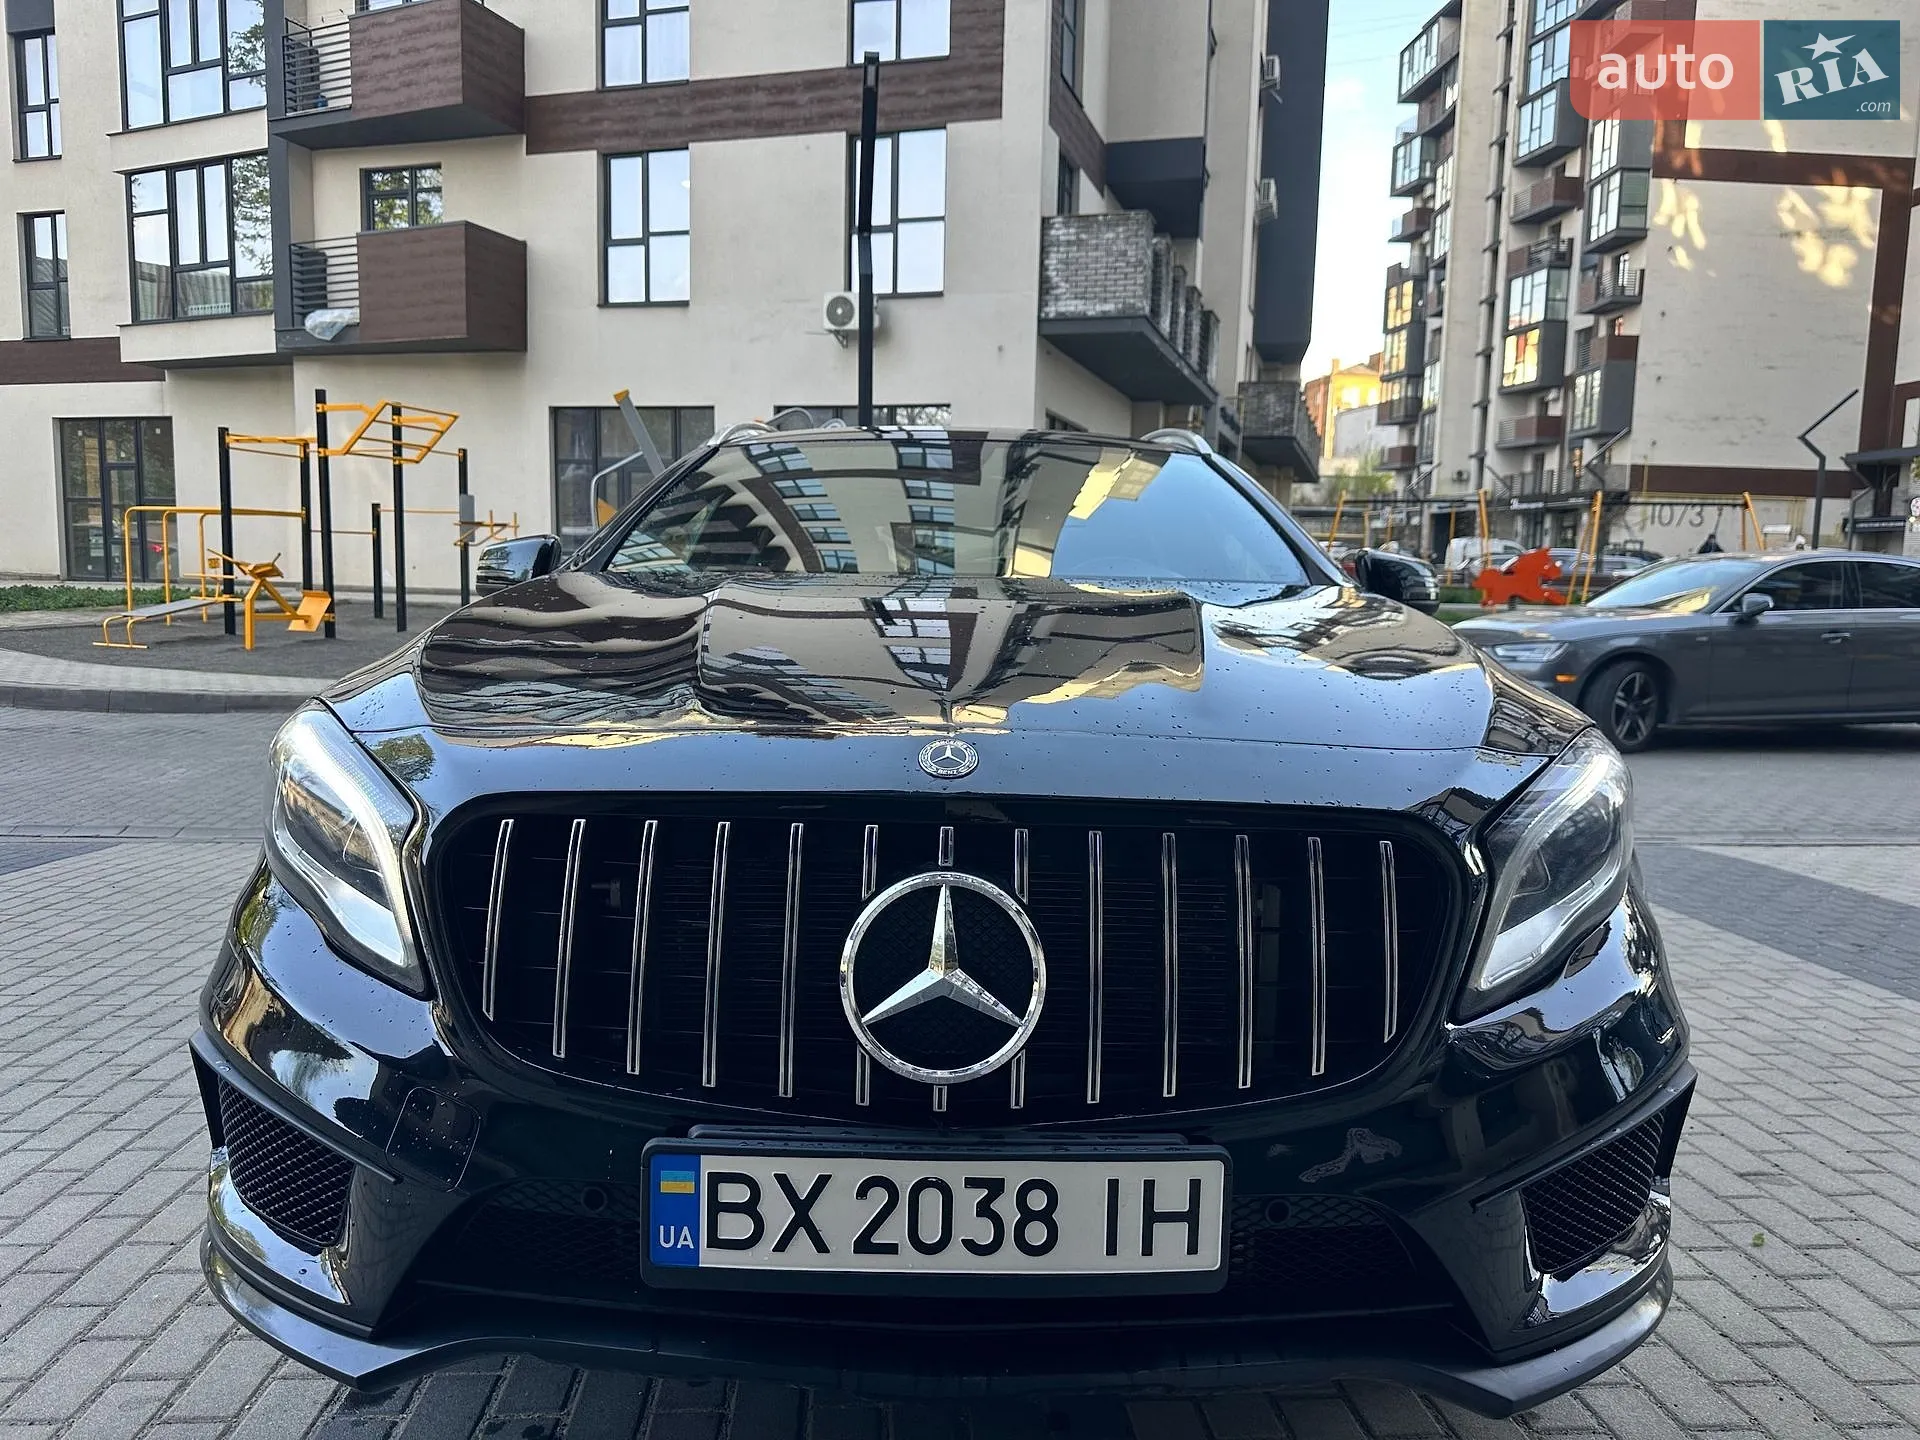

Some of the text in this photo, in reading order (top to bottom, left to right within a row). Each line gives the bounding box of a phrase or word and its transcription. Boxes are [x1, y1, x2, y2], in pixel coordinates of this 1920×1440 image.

[659, 1224, 695, 1250] UA
[706, 1171, 1202, 1258] BX 2038 IH
